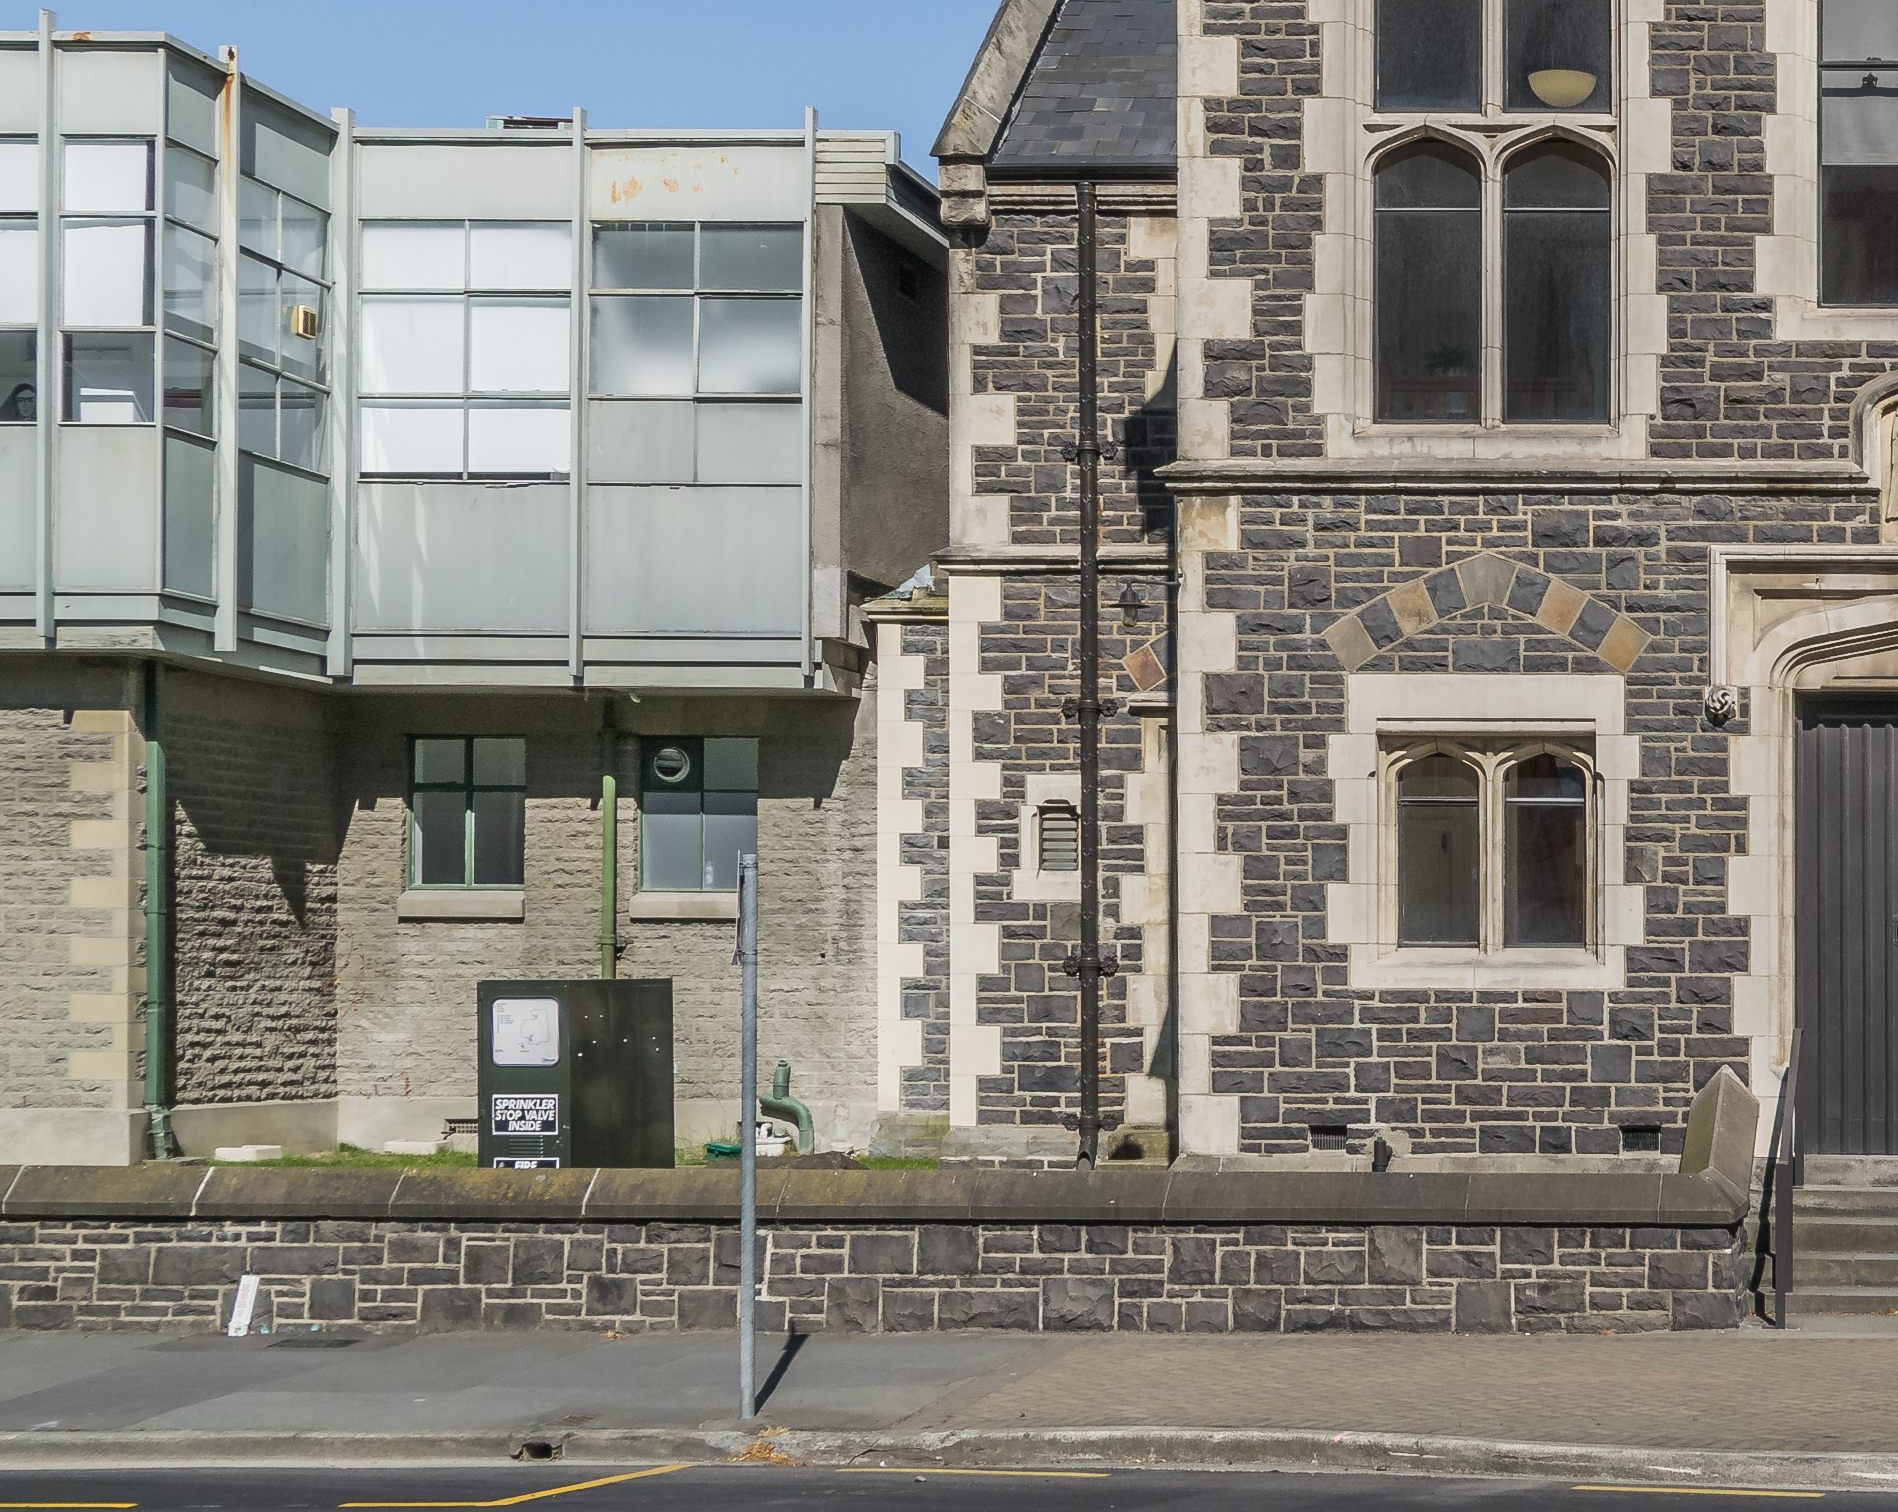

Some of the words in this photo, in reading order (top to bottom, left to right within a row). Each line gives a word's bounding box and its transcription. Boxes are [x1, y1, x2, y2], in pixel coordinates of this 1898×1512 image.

[495, 1099, 555, 1110] SPRINKLER
[495, 1110, 523, 1121] STOP
[524, 1110, 555, 1121] VALVE
[508, 1120, 543, 1131] INSIDE
